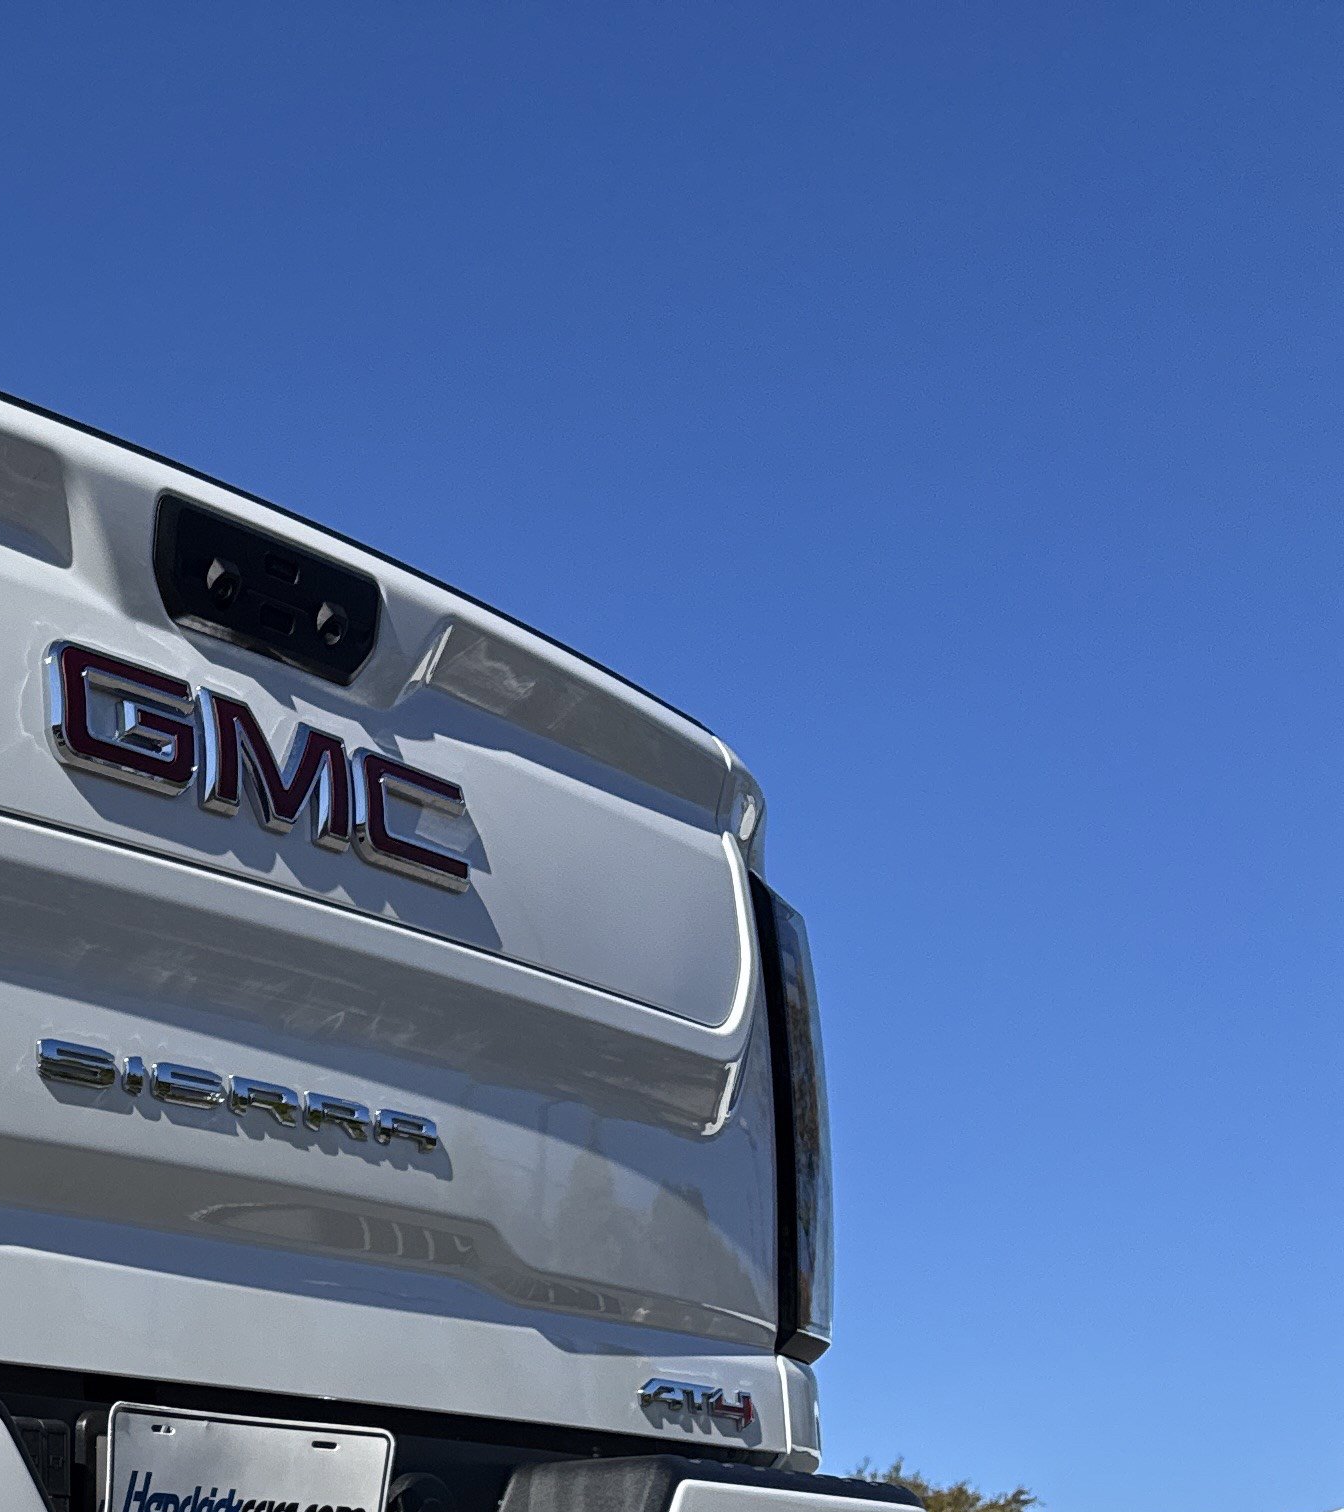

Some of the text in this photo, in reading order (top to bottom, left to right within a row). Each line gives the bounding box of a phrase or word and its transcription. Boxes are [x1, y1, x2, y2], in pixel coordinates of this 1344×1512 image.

[43, 638, 470, 893] GMC
[36, 1037, 438, 1153] SIERRA
[637, 1377, 754, 1432] AT4
